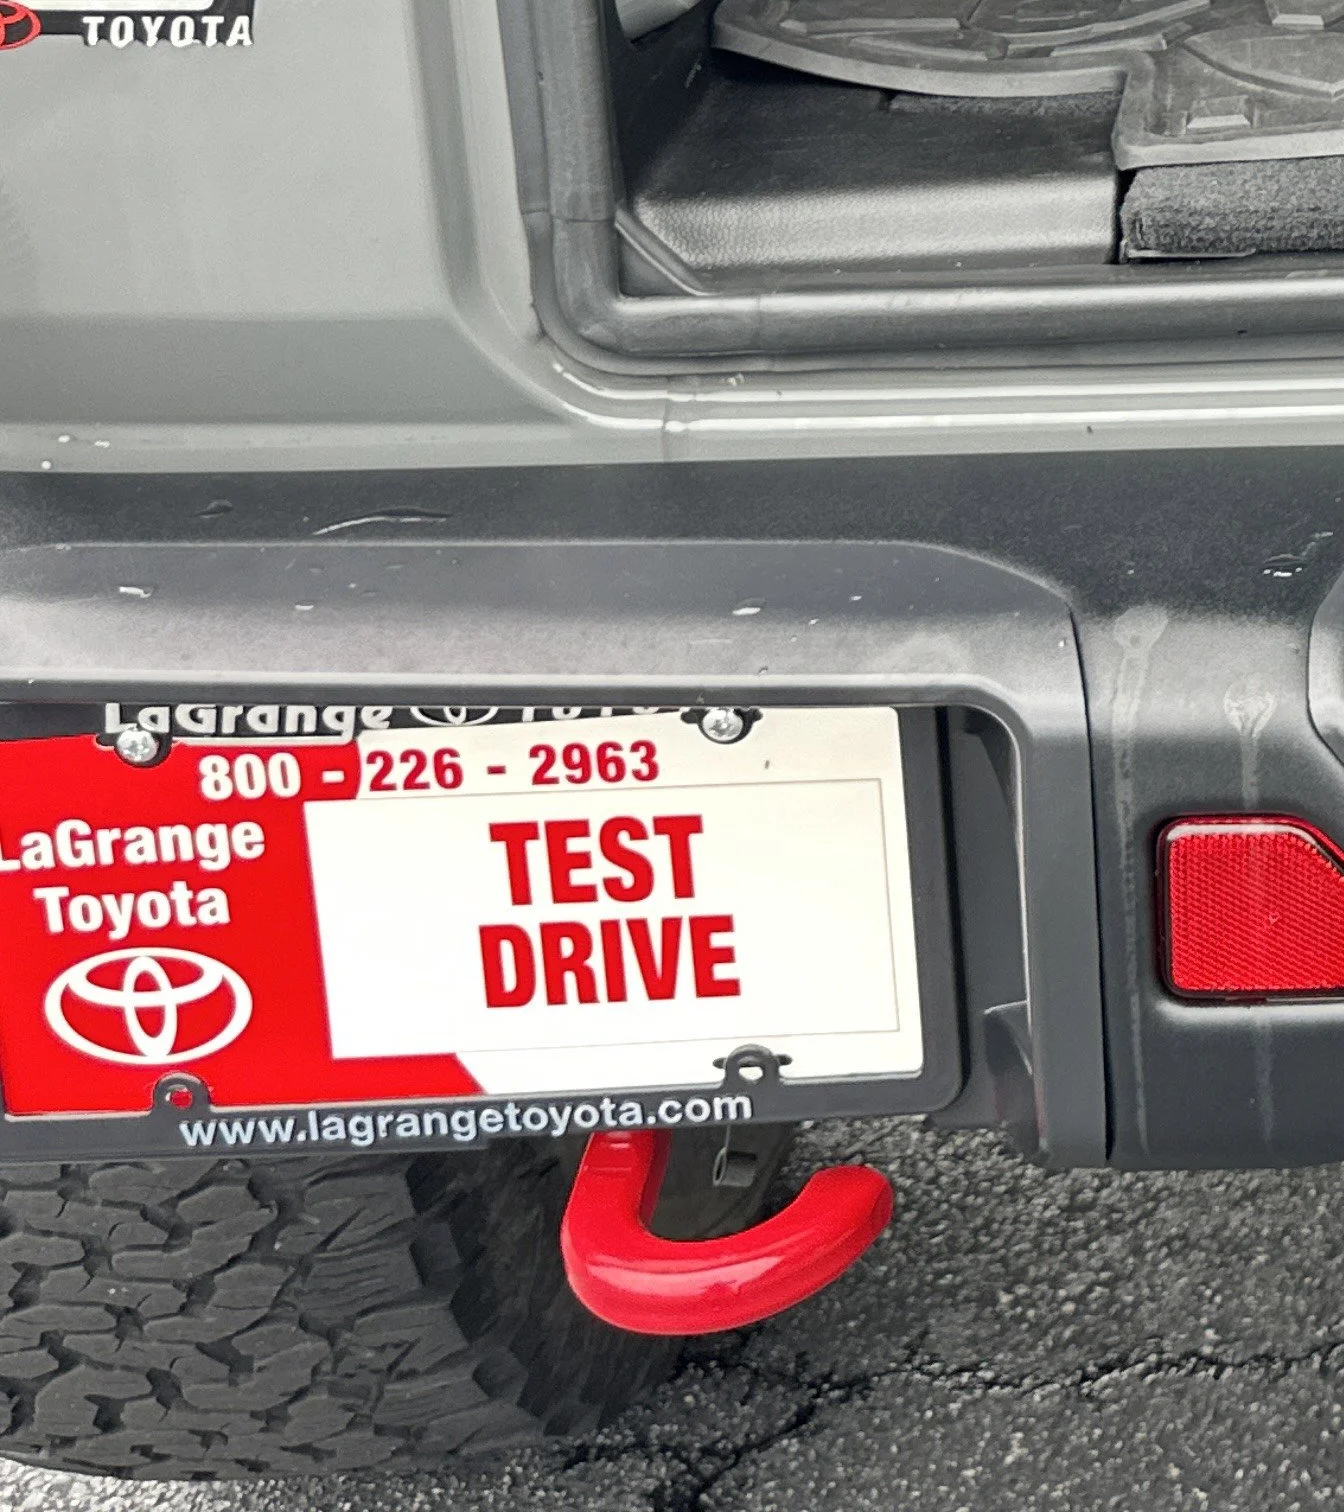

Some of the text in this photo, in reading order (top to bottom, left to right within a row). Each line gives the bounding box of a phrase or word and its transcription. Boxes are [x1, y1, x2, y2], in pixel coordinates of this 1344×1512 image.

[83, 15, 252, 48] TOYOTA
[199, 752, 301, 801] 800
[366, 747, 464, 791] 226
[528, 739, 660, 786] 2963
[488, 814, 704, 906] TEST
[33, 880, 231, 940] Toyota
[478, 914, 742, 1009] DRIVE
[179, 1092, 753, 1148] www.lagrangetoyota.com
